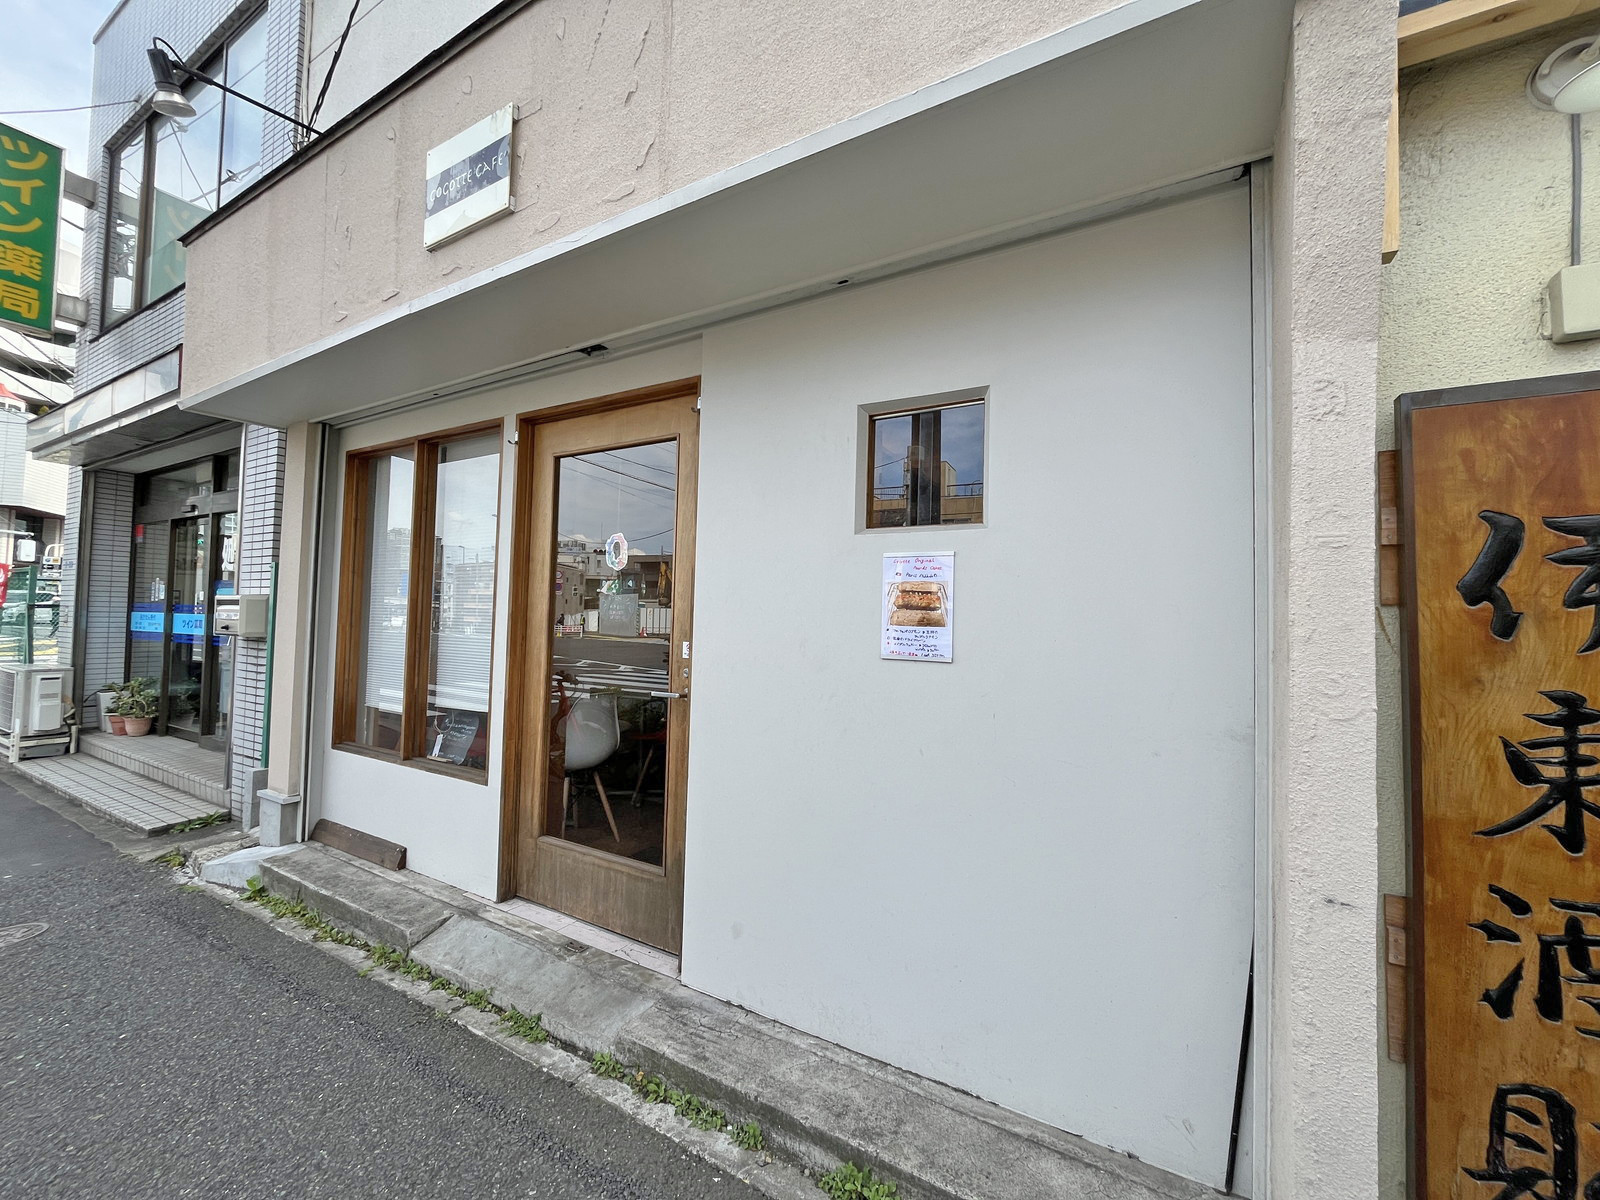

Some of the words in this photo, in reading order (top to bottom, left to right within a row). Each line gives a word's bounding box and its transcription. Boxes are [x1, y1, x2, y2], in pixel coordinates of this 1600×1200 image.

[0, 135, 49, 320] ツイン薬局
[429, 169, 473, 202] COCOTTE
